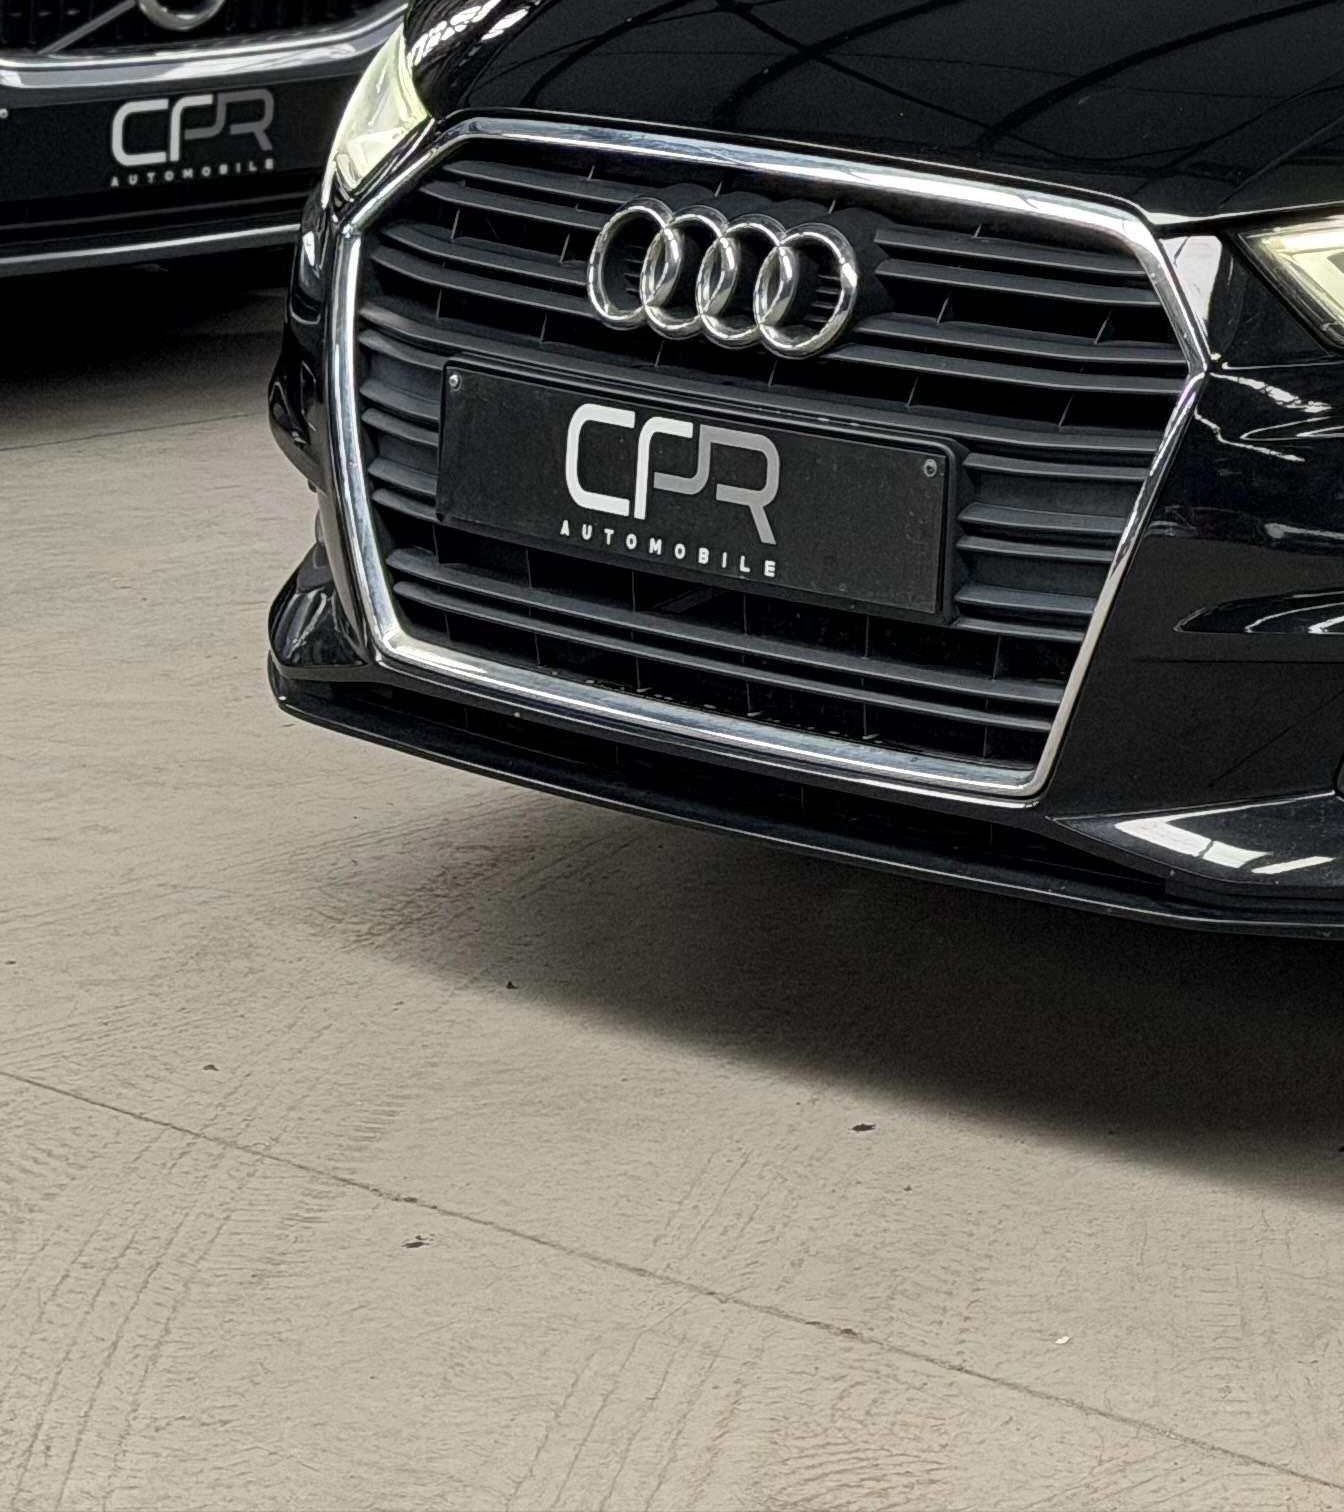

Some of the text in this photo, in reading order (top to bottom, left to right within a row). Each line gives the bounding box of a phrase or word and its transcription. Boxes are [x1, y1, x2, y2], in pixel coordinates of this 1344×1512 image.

[111, 88, 275, 167] CPR
[110, 157, 275, 188] AUTOMOBILE
[564, 401, 781, 546] CPR
[559, 518, 777, 579] AUTOMOBILE
